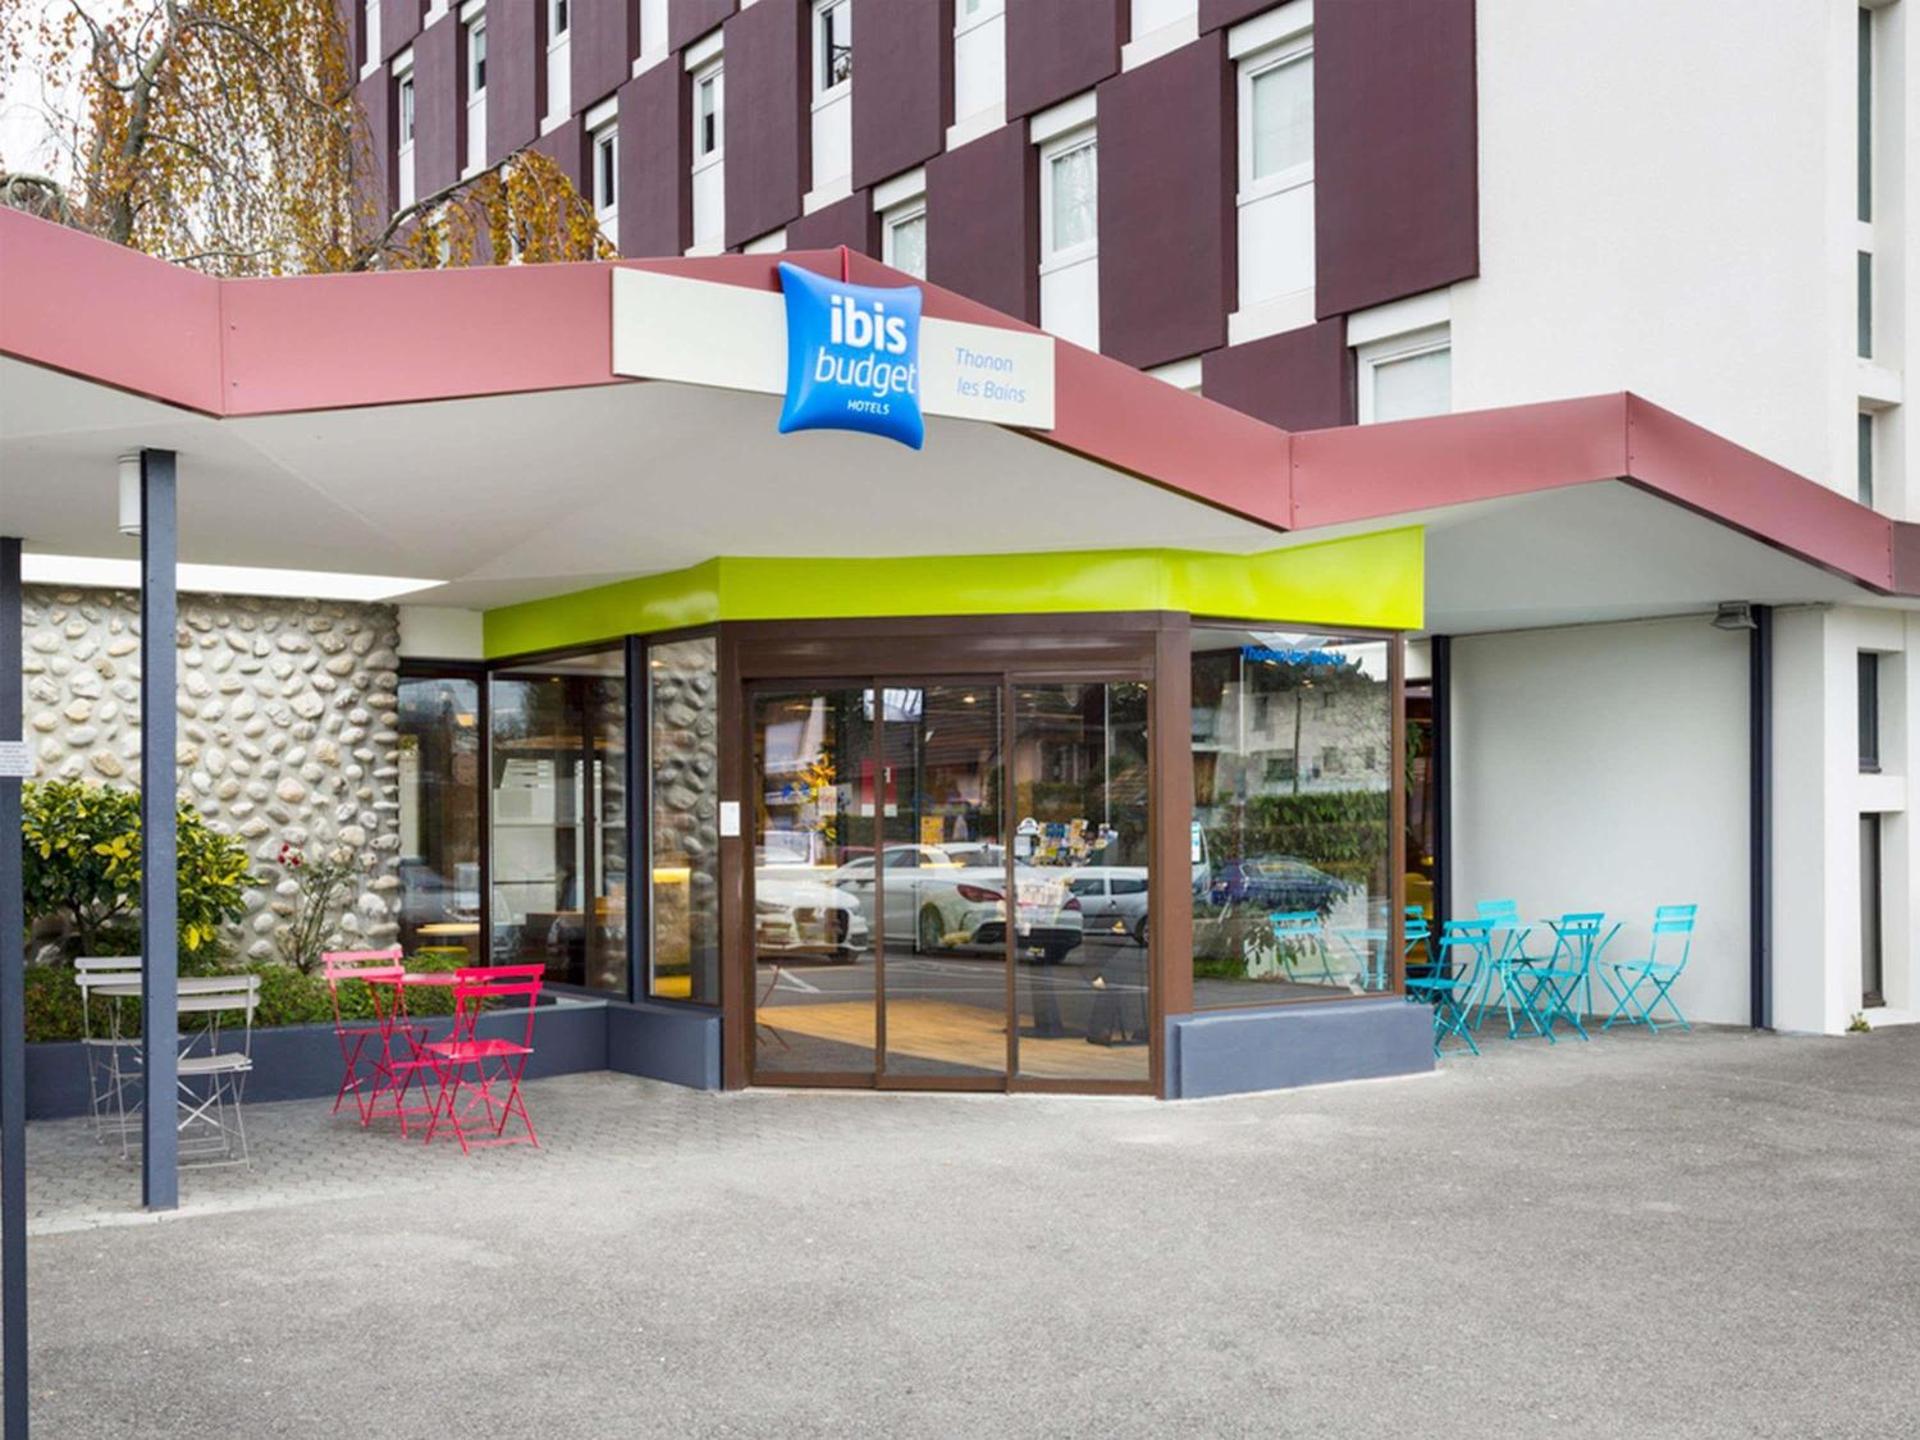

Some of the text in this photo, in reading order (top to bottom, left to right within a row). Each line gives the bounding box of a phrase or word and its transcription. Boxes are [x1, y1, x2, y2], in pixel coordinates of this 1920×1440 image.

[831, 294, 907, 354] ibis
[815, 346, 916, 397] budget
[956, 347, 1012, 373] Thonon
[957, 378, 1025, 403] les Bains
[847, 399, 890, 415] HOTELS
